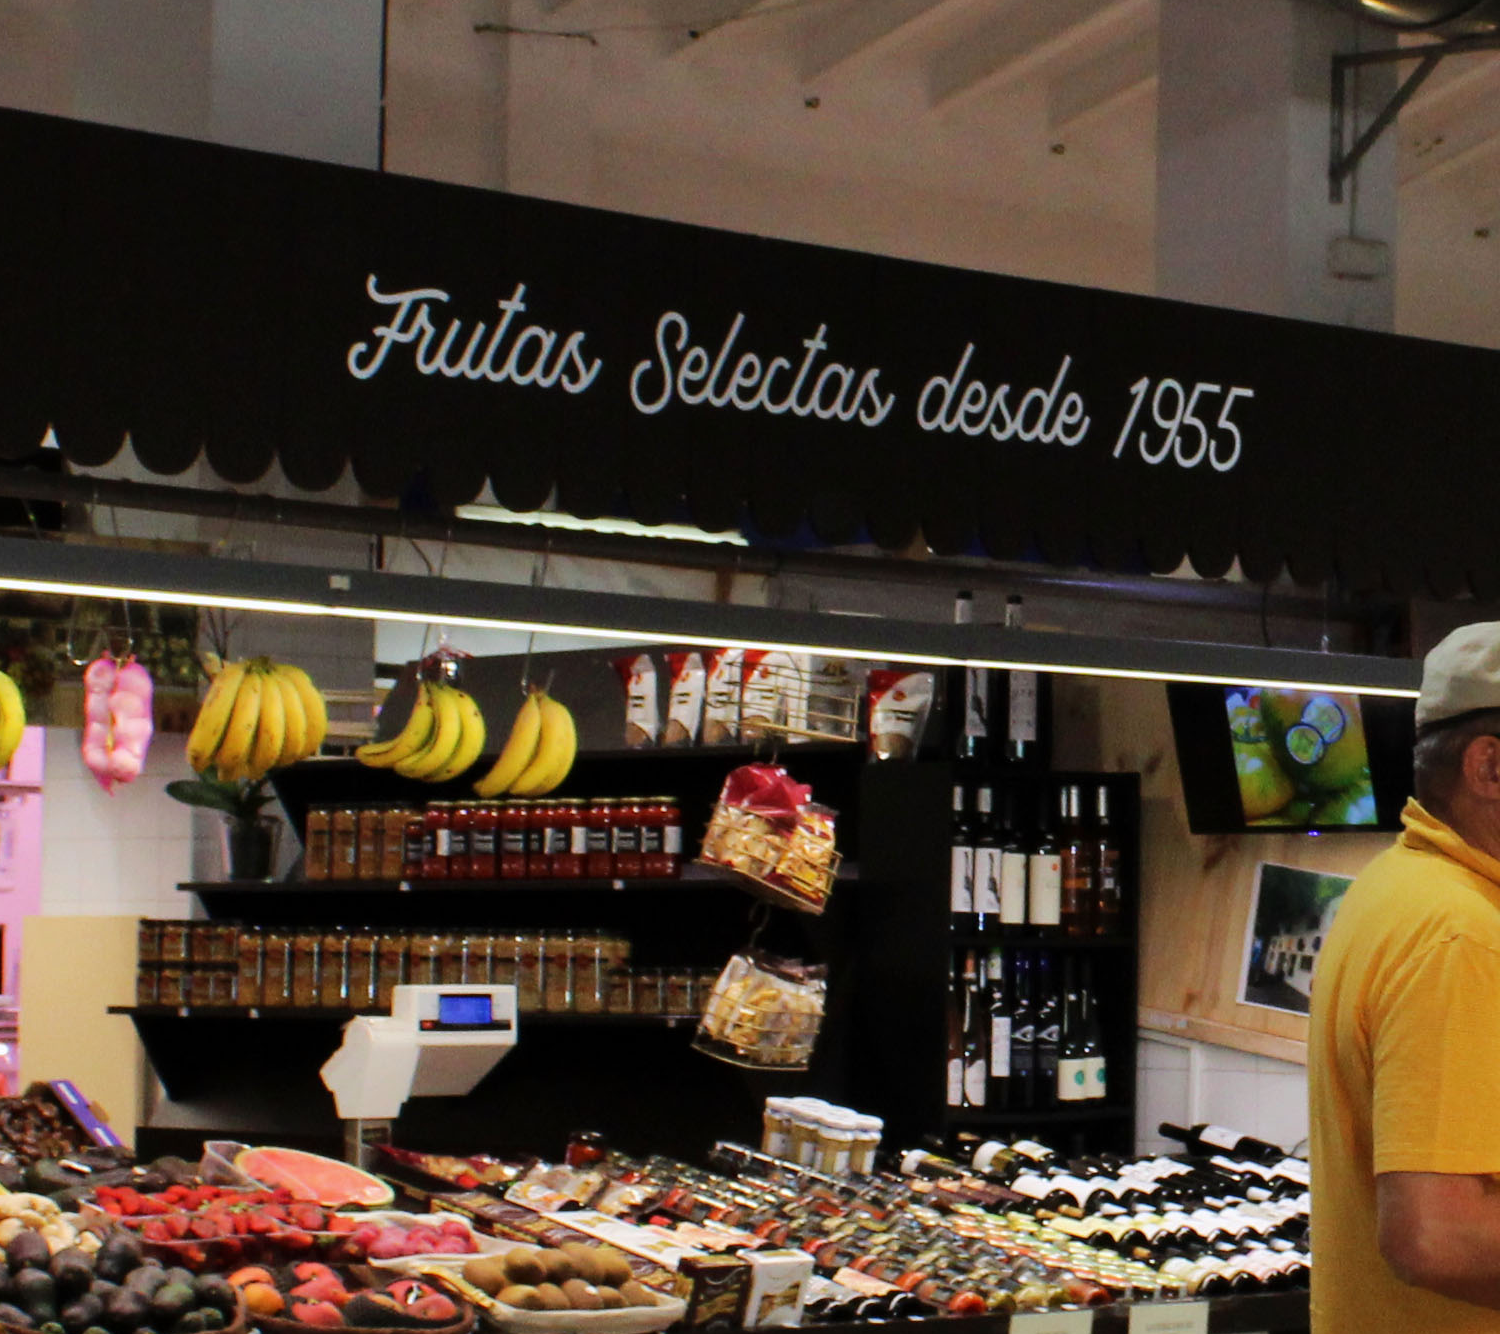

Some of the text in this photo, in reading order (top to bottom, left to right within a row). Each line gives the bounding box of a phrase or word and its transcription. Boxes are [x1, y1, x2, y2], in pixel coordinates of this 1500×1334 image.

[347, 273, 1256, 473] Frutas Selectas desde 1955
